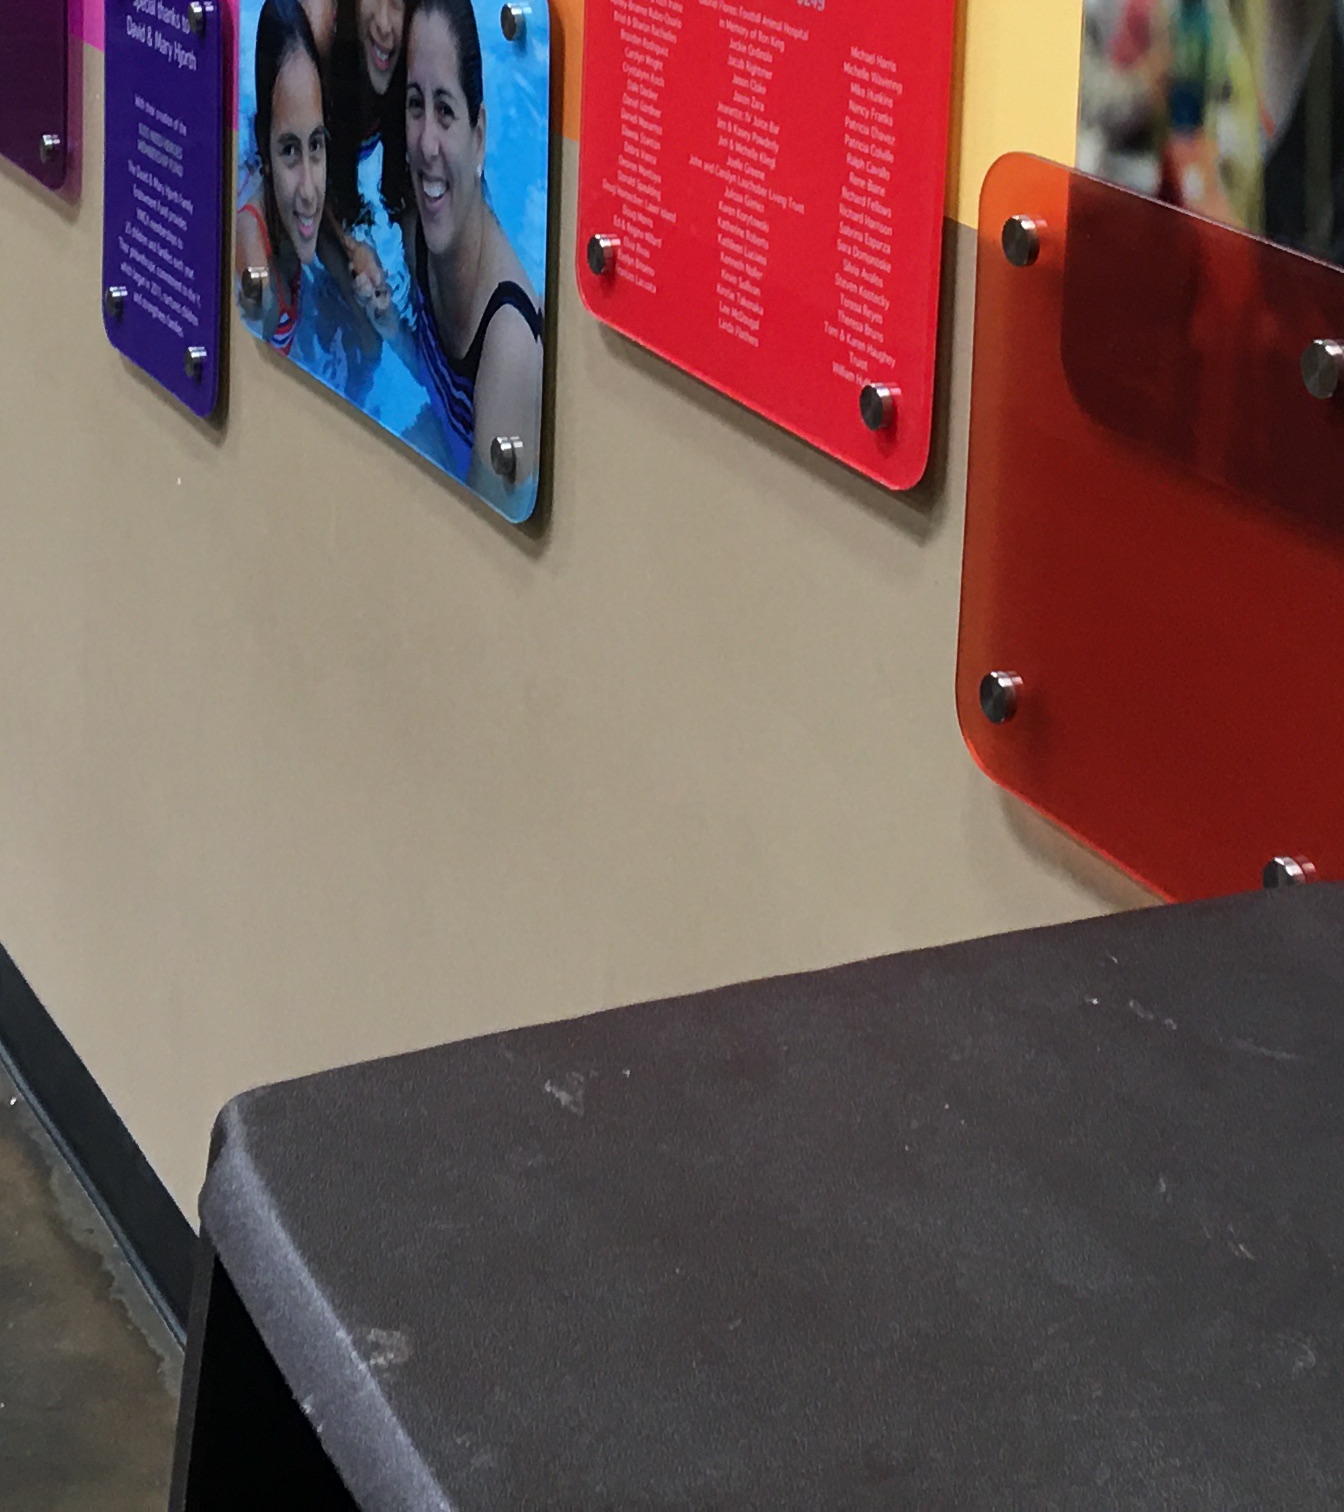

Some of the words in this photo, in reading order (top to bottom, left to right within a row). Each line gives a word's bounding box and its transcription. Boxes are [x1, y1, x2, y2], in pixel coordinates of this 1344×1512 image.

[158, 0, 180, 29] thanks
[182, 14, 190, 34] to
[127, 15, 145, 42] David
[147, 26, 152, 46] &
[154, 30, 172, 62] Mary
[839, 329, 845, 341] &
